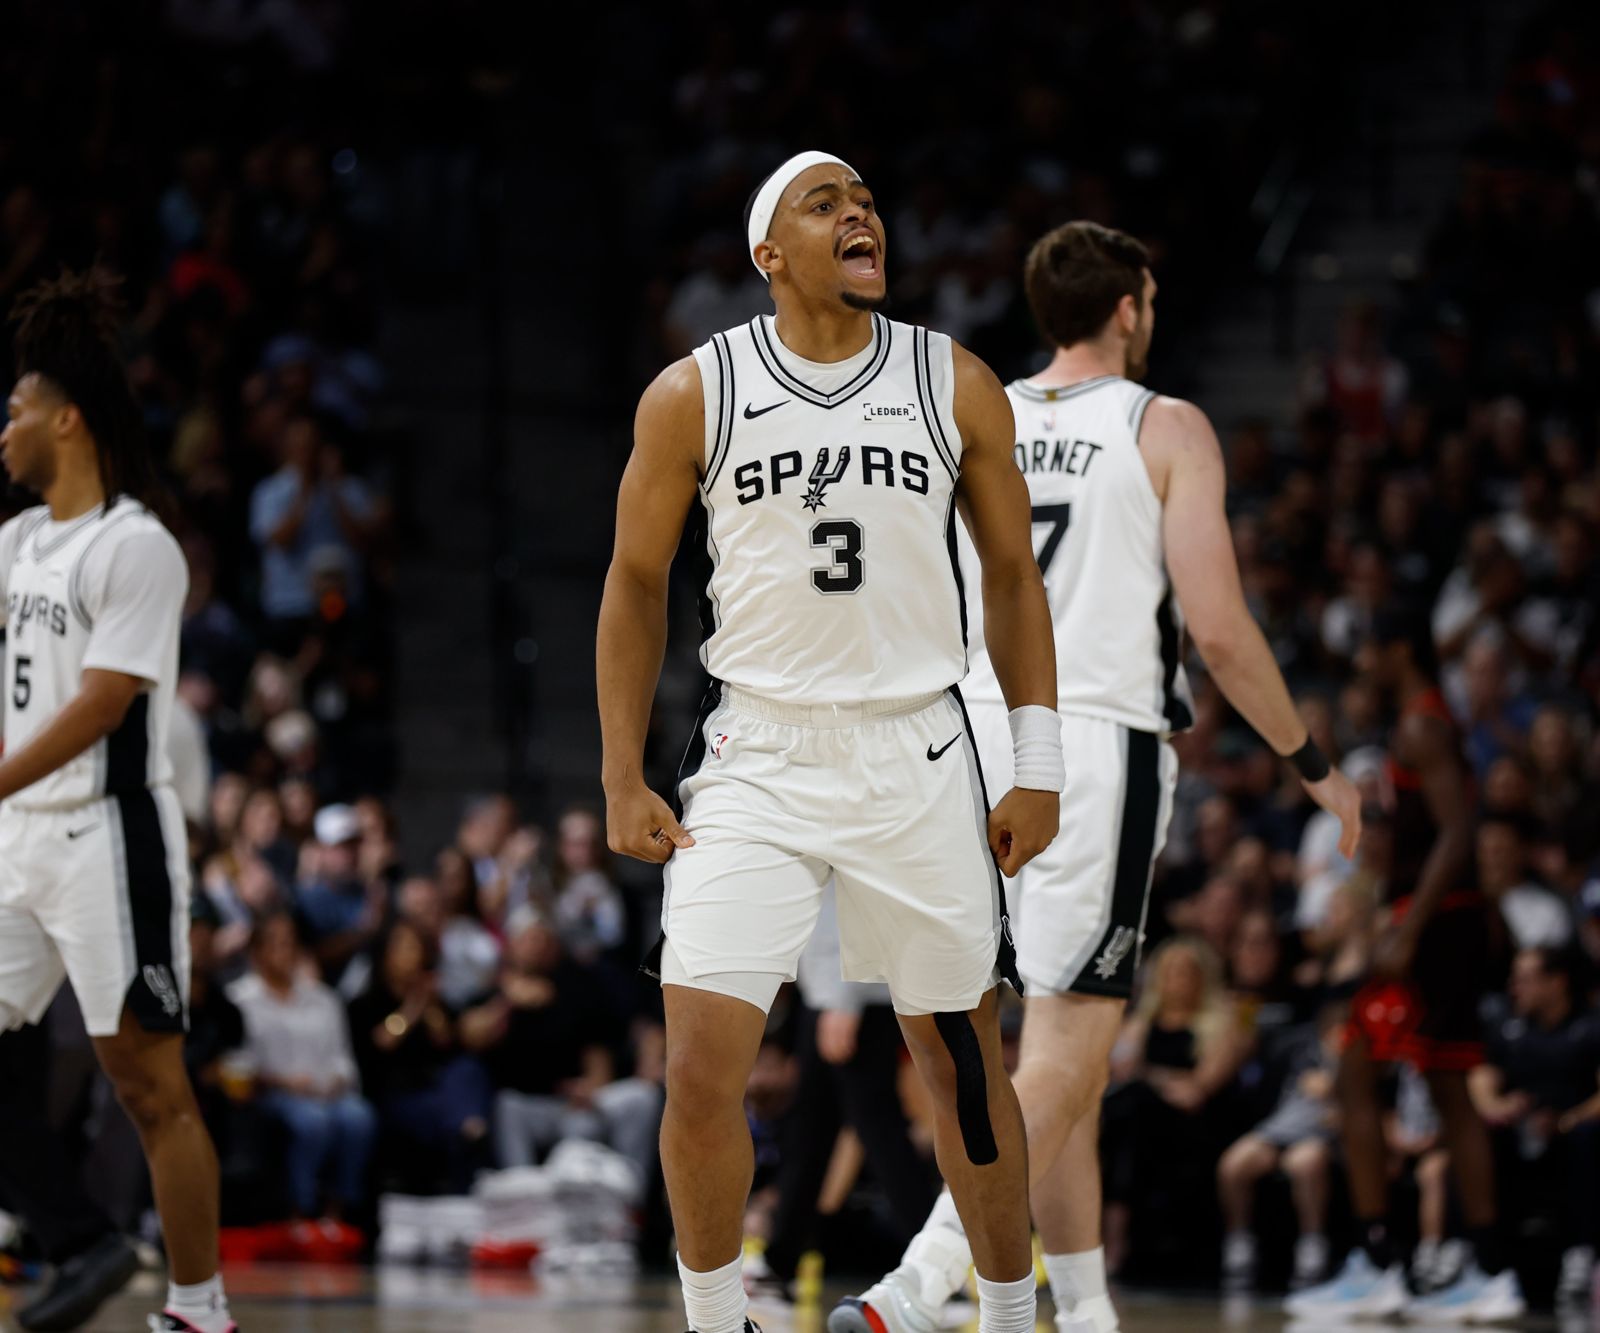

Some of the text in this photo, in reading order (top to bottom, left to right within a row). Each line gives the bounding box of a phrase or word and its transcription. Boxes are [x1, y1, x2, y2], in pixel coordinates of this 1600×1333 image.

[870, 407, 909, 416] LEDGER
[734, 446, 929, 513] SPURS
[809, 518, 866, 596] 3
[1031, 502, 1071, 576] 7
[13, 655, 32, 711] 5
